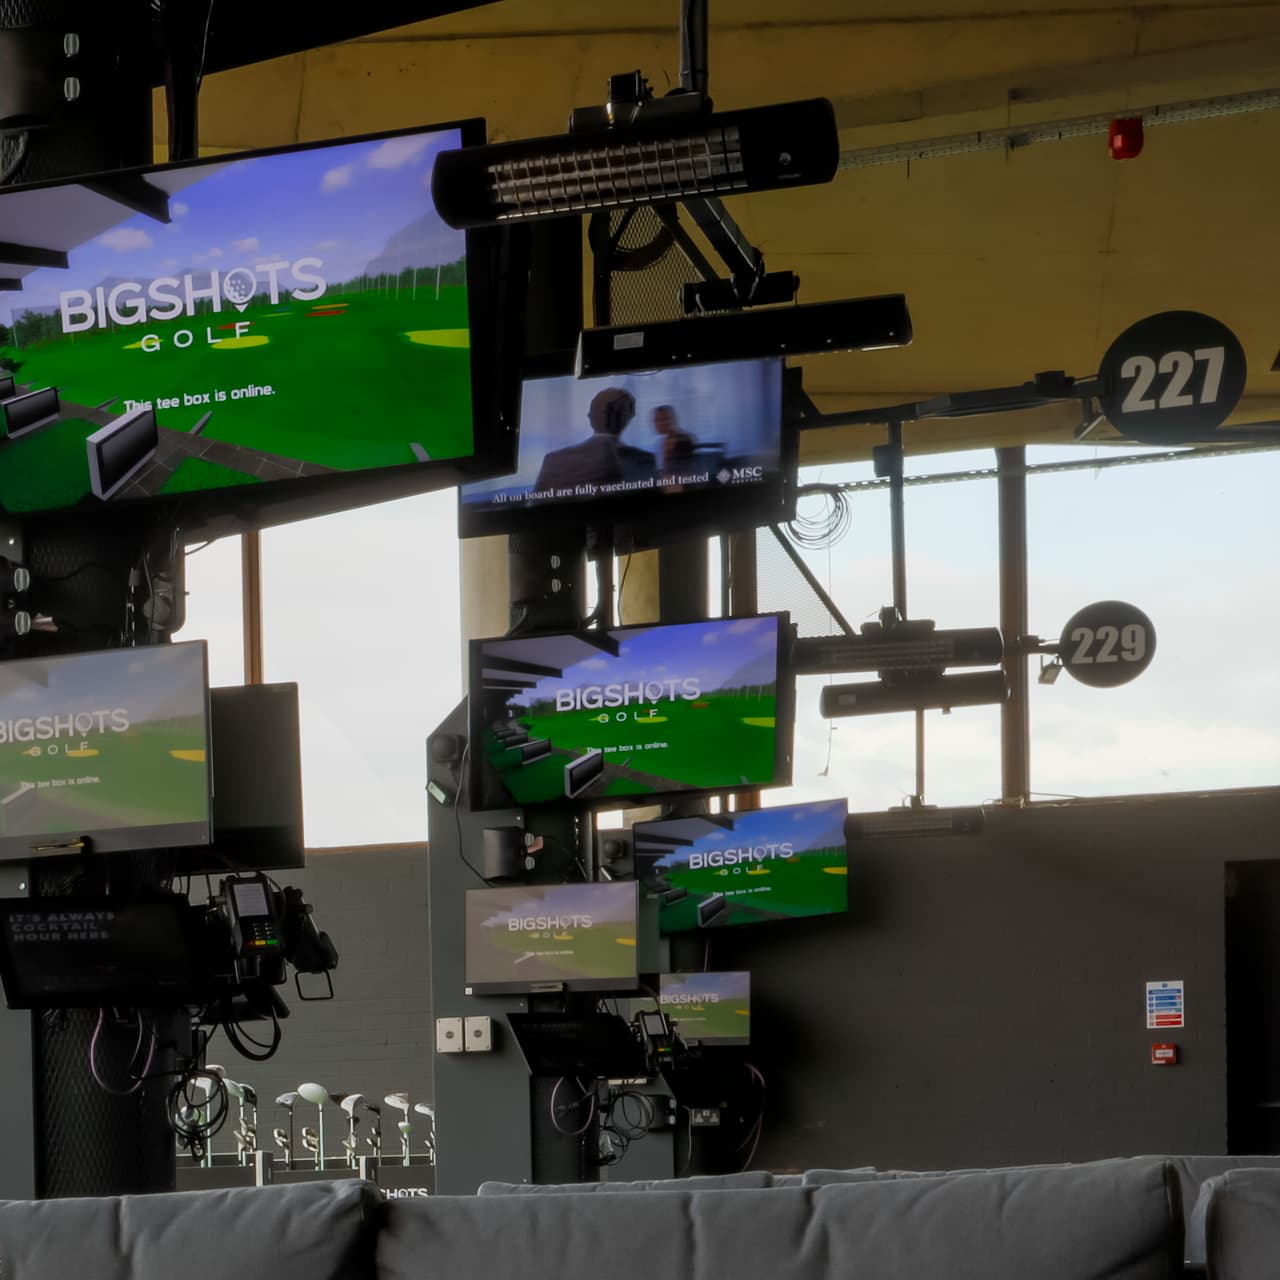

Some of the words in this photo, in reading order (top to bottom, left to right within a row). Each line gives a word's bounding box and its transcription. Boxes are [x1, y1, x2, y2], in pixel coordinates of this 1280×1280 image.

[59, 257, 327, 334] BIGSHOTS
[141, 321, 251, 352] GOLF
[1120, 346, 1225, 414] 227
[156, 396, 180, 409] tee
[183, 391, 210, 407] box
[214, 389, 227, 402] is
[230, 384, 276, 400] online.
[732, 466, 762, 479] MSC
[524, 487, 554, 499] board
[556, 487, 573, 498] are
[575, 483, 597, 498] fully
[599, 477, 654, 493] vaccinated
[656, 474, 676, 487] and
[678, 471, 709, 485] tested
[1071, 624, 1146, 665] 229
[556, 677, 702, 712] BIGSHOTS
[598, 709, 658, 724] GOLF
[31, 741, 88, 757] GOLF
[690, 843, 794, 870] BIGSHOTS
[48, 911, 116, 922] ALWAYS
[508, 915, 593, 931] BIGSHOTS
[11, 921, 97, 933] COCKTAIL
[13, 932, 61, 942] HOUR
[68, 930, 111, 941] HERE
[379, 1187, 429, 1200] HOTS
